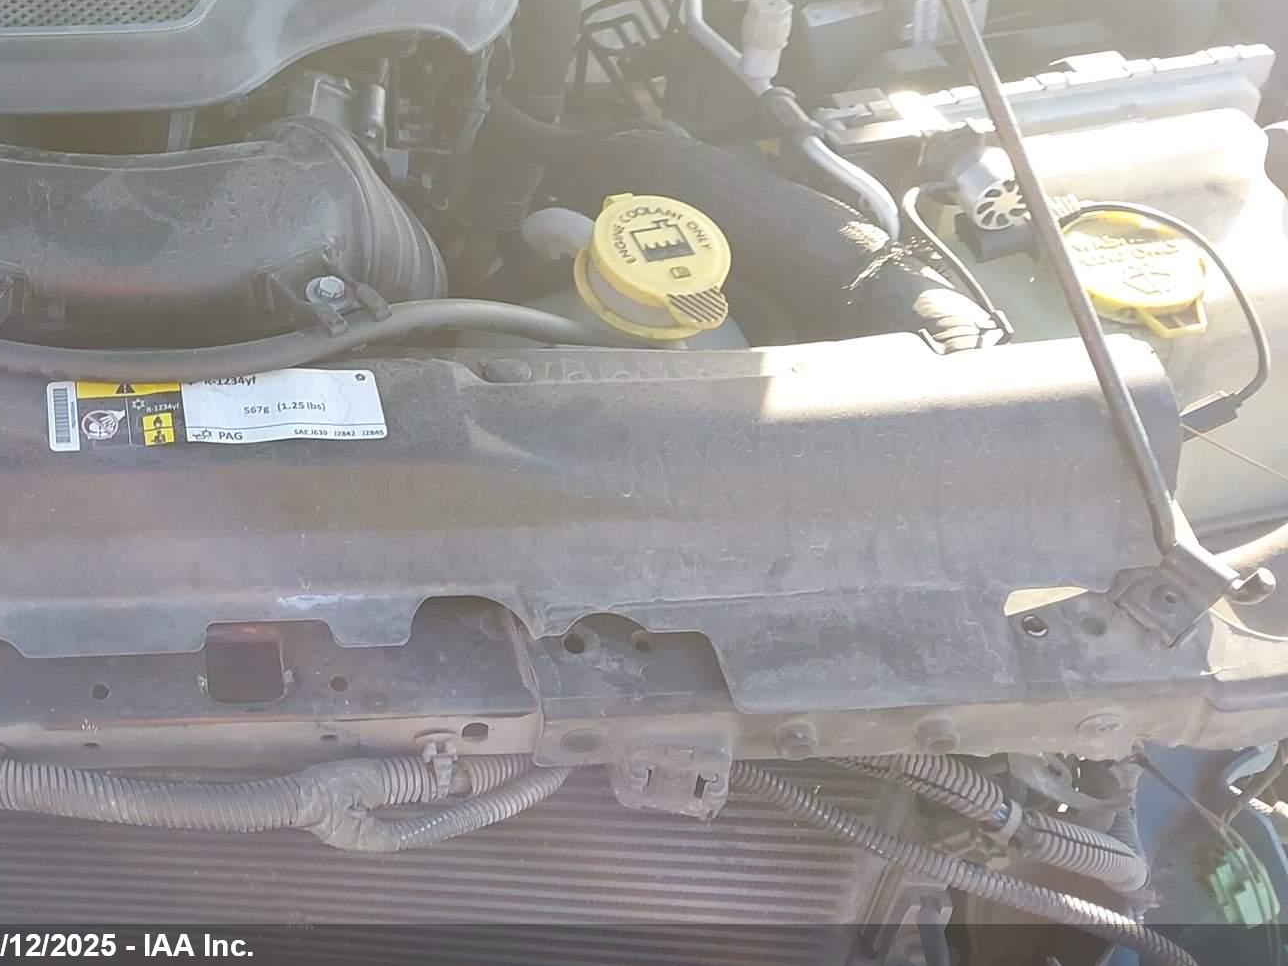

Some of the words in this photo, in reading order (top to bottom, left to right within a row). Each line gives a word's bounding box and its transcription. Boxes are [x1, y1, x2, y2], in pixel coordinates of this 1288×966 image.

[619, 206, 686, 223] COOLANT
[686, 220, 713, 251] ONLY
[243, 405, 270, 415] 567g
[277, 401, 305, 413] (1.25
[306, 401, 326, 412] lbs)
[218, 431, 243, 441] PAG
